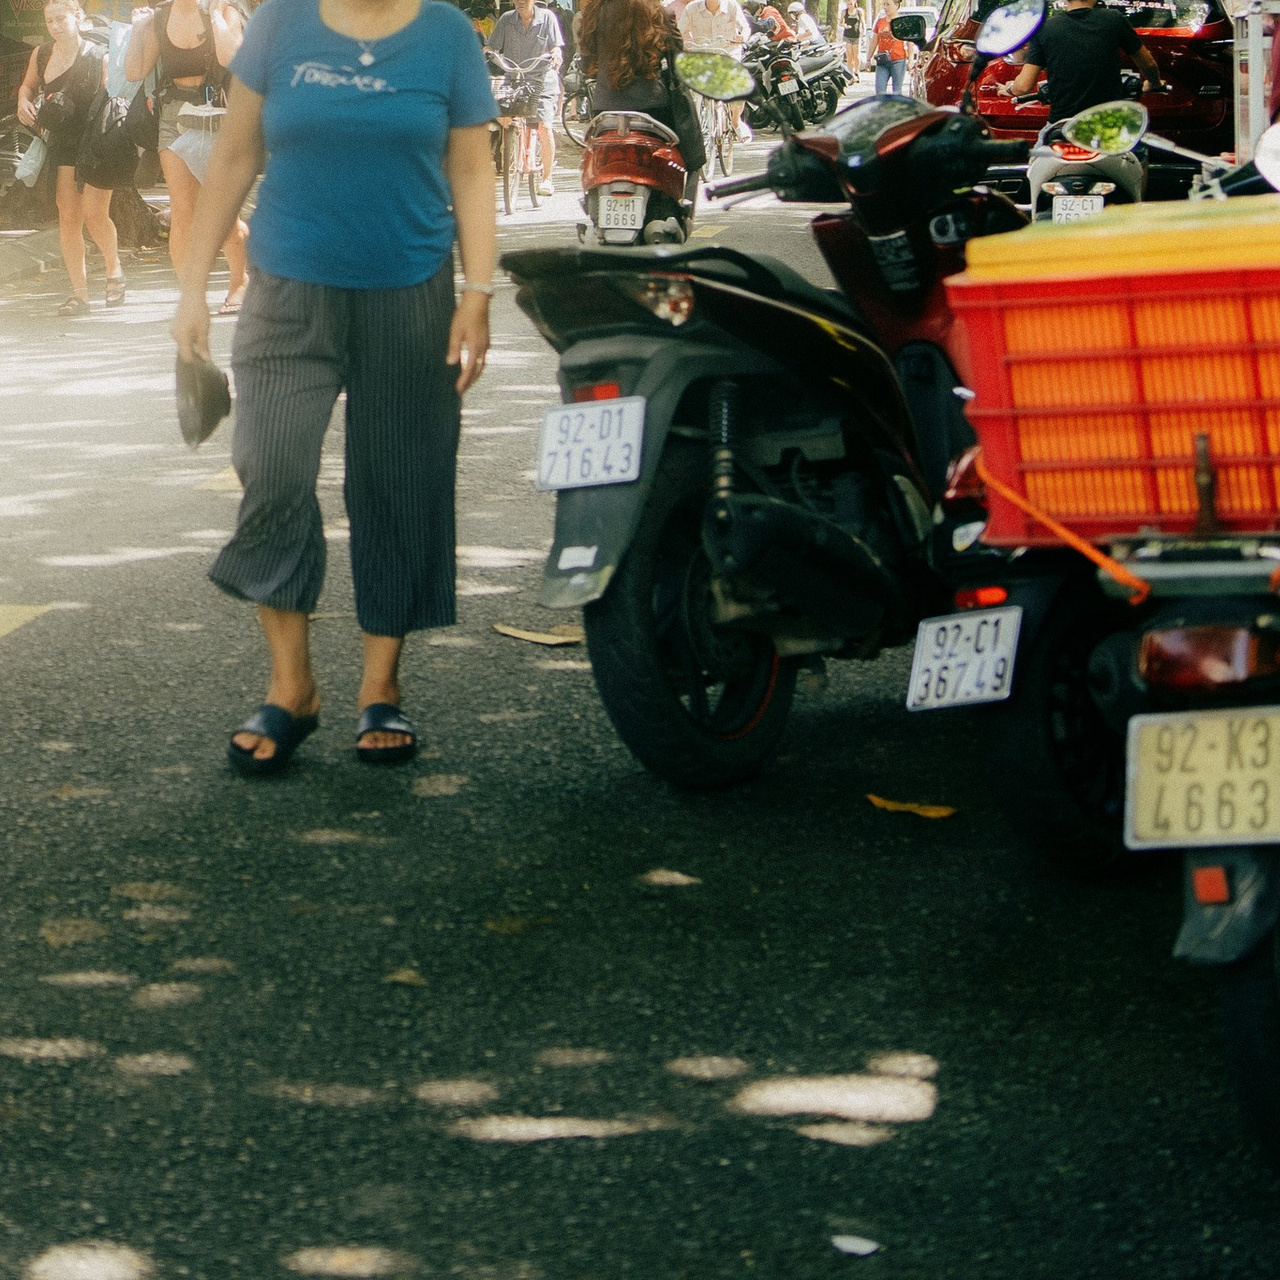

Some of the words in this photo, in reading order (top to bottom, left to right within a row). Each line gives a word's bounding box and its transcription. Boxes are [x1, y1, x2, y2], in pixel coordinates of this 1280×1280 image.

[605, 213, 637, 226] 8669
[606, 199, 635, 212] 92-H1
[1061, 199, 1095, 211] 92-C1
[557, 407, 625, 446] 92-D1
[933, 618, 1001, 660] 92-C1
[1155, 718, 1271, 774] 92-K3
[1152, 779, 1270, 835] 4663
